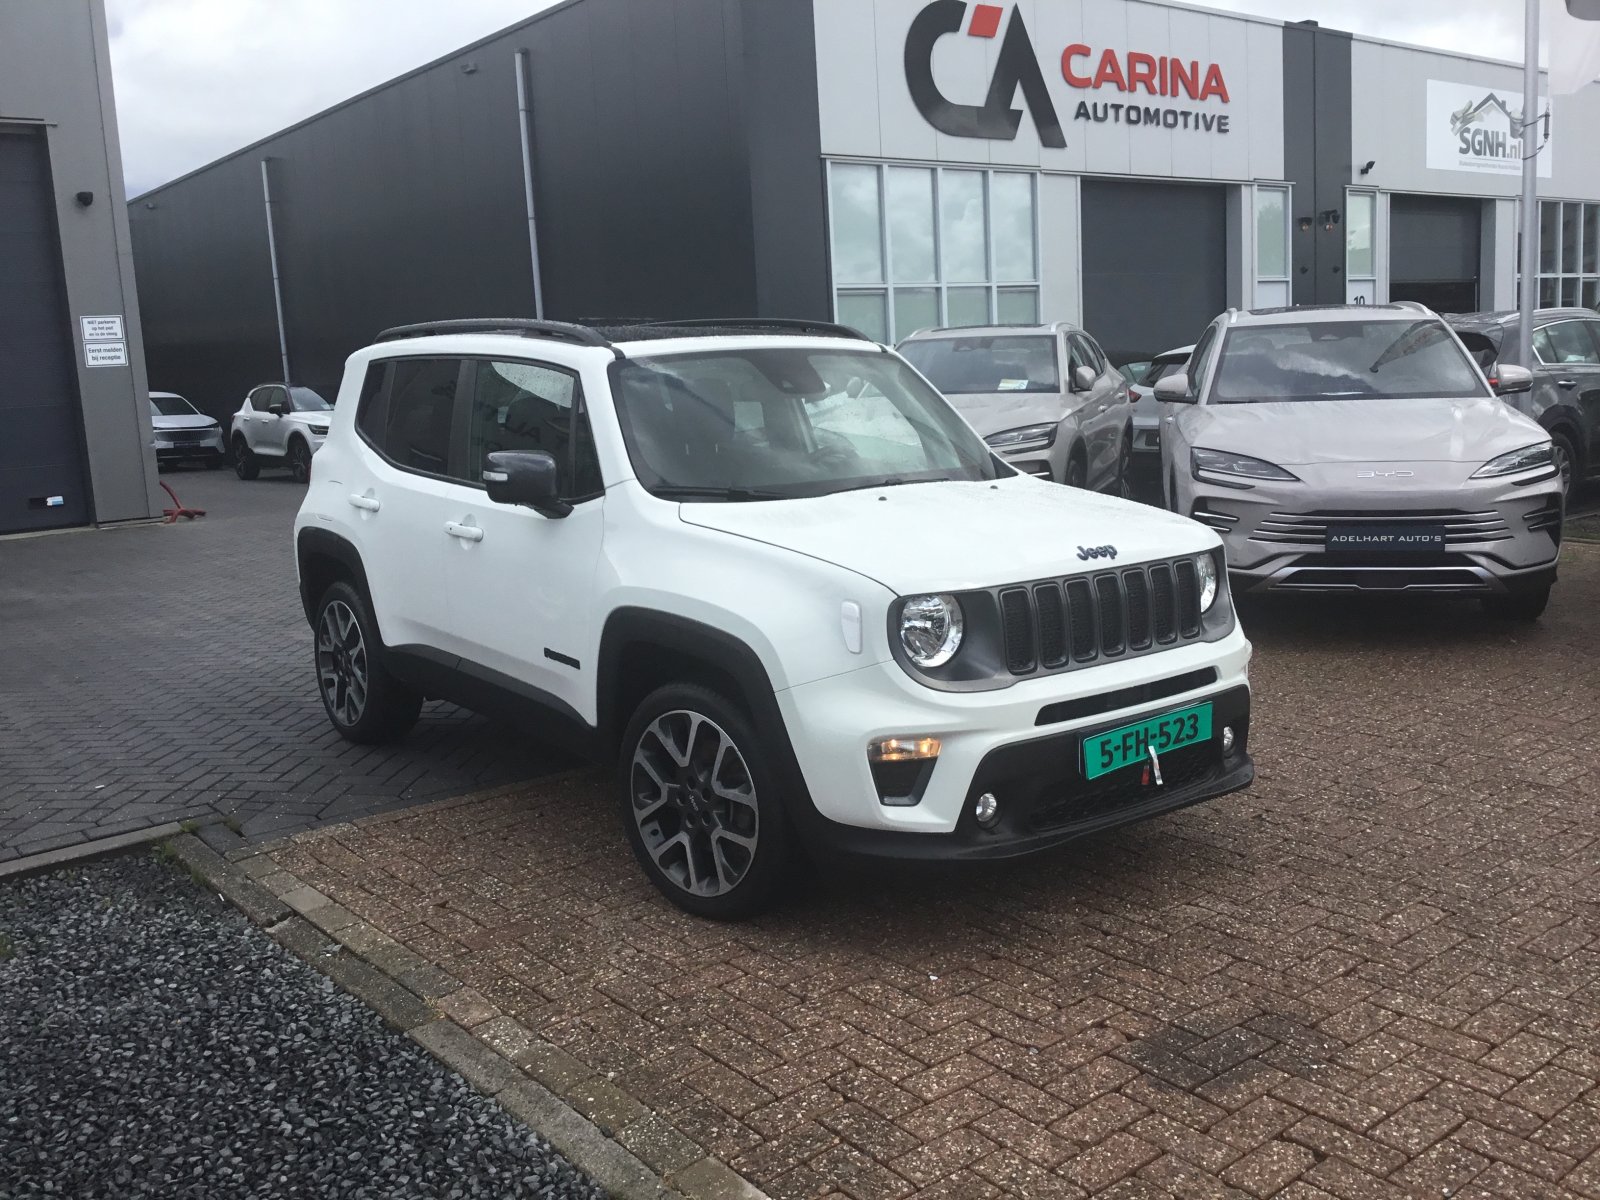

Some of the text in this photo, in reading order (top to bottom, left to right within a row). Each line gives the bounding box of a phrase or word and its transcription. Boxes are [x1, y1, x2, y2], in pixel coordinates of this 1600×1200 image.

[1061, 44, 1230, 103] CARINA
[1074, 101, 1230, 133] AUTOMOTIVE
[1458, 126, 1521, 160] SGNH.nl
[1076, 544, 1118, 561] Jeep
[1101, 713, 1199, 768] 5-FH-523
